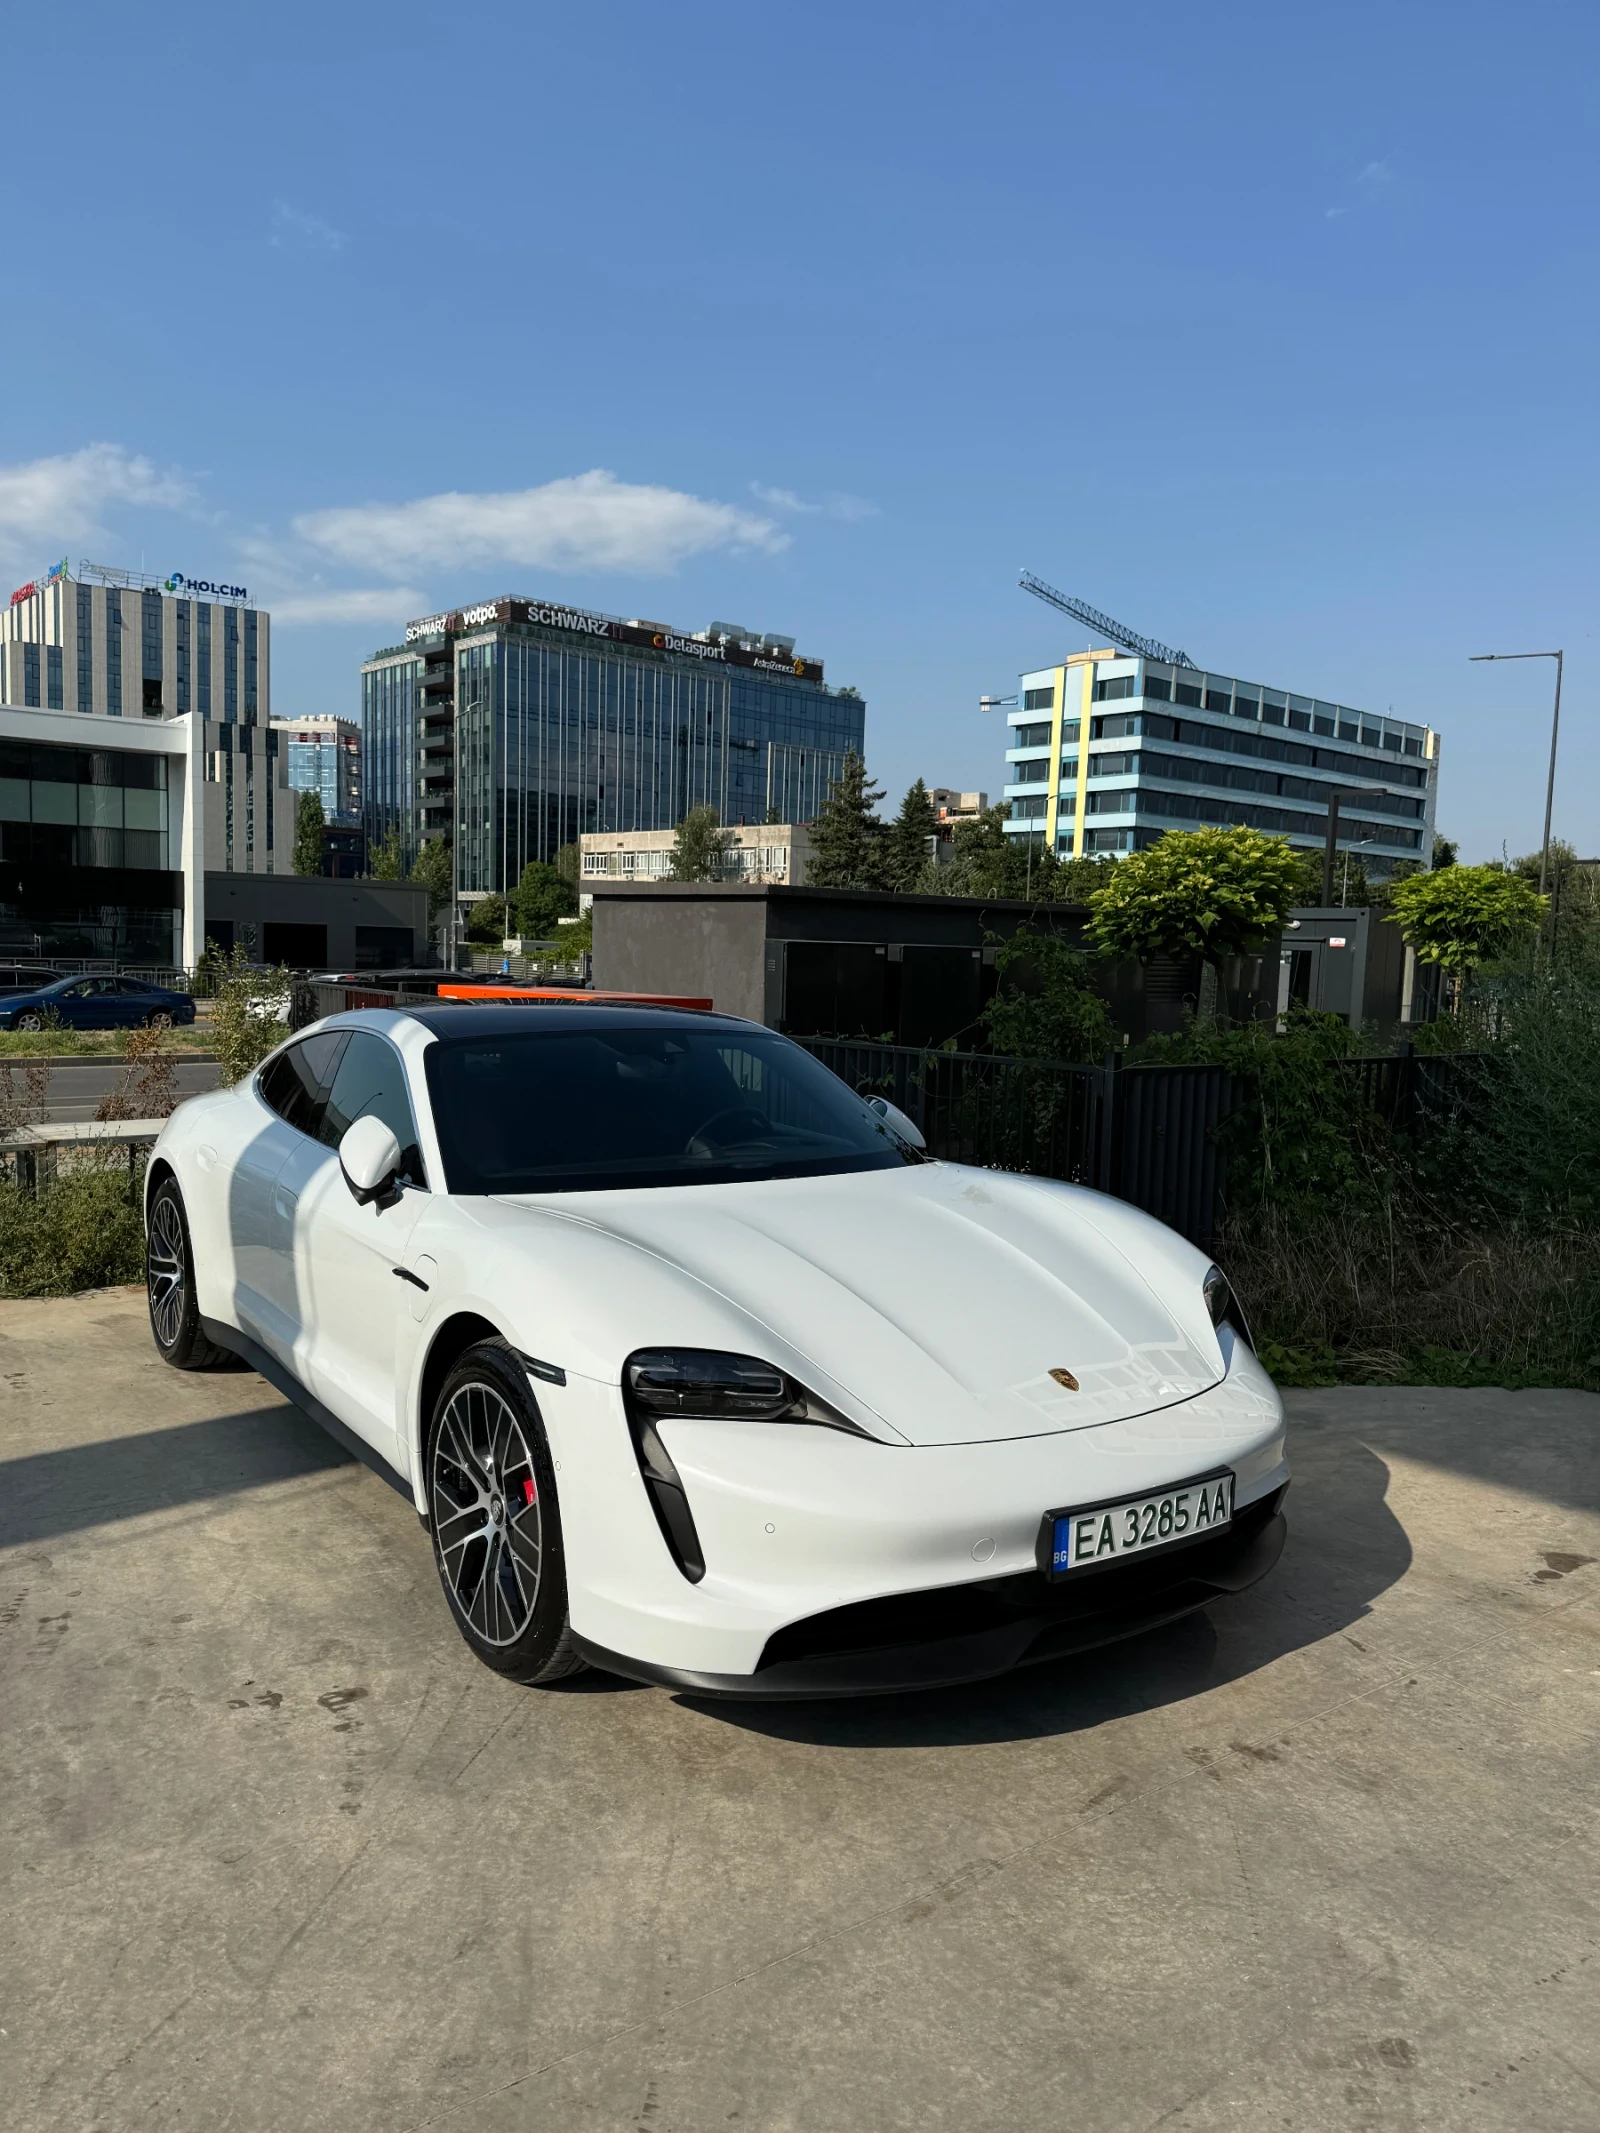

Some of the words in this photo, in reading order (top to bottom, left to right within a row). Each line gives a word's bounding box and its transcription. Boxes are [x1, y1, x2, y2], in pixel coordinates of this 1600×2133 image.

[187, 578, 247, 599] HOLCIM
[406, 617, 447, 642] SCHWARZ
[527, 606, 609, 637] SCHWARZ
[664, 634, 726, 661] Delasport
[753, 657, 796, 675] AstraZeneca
[1074, 1513, 1116, 1561] EA
[1120, 1493, 1190, 1548] 3285
[1193, 1482, 1227, 1528] AA
[1053, 1550, 1067, 1564] BG
